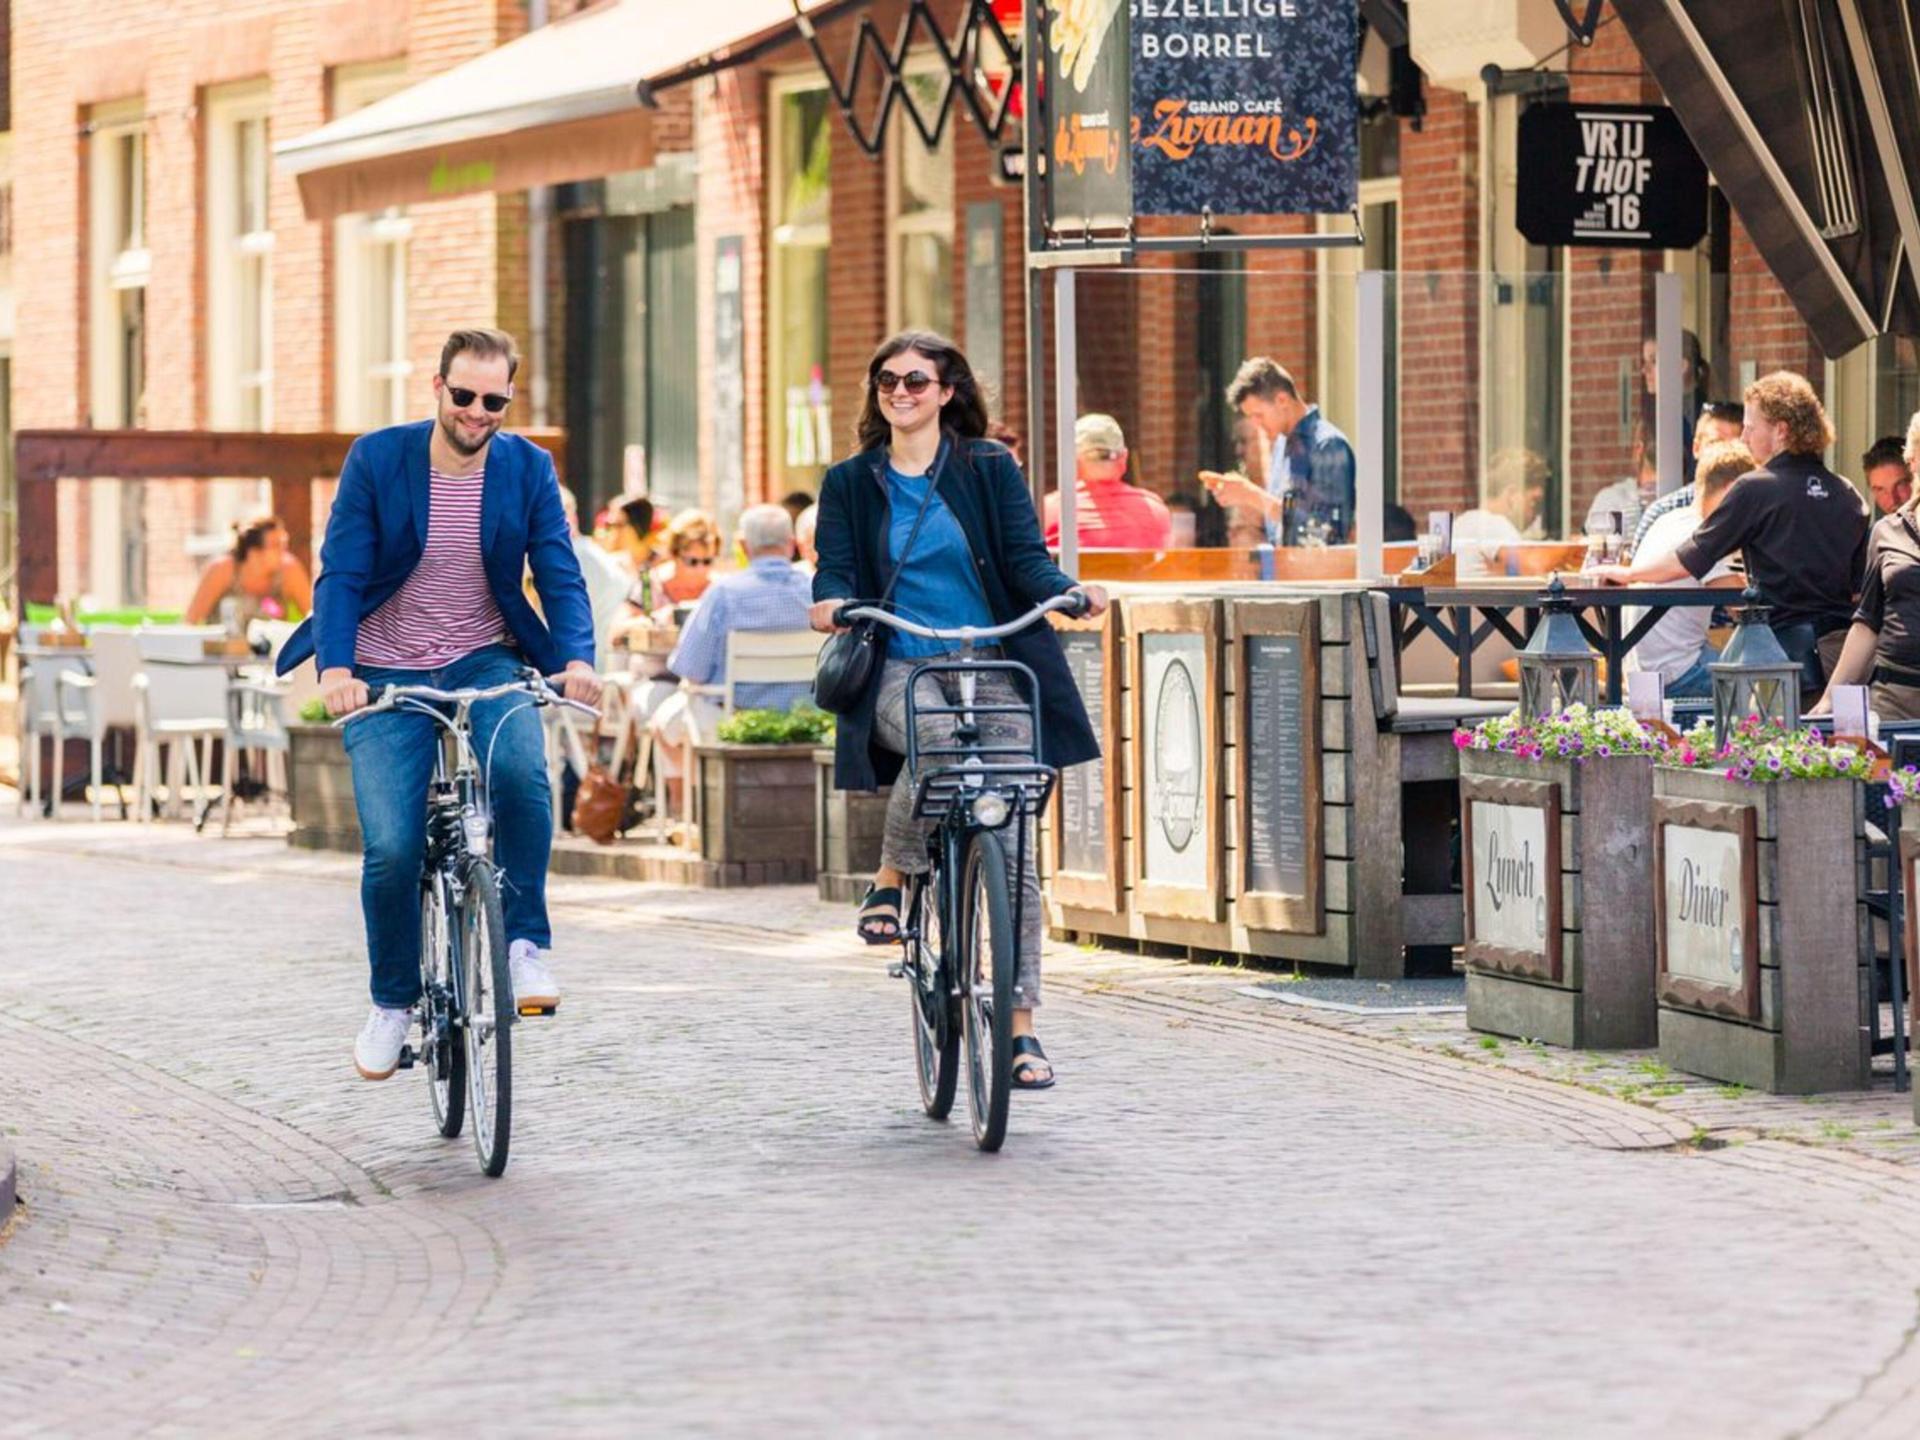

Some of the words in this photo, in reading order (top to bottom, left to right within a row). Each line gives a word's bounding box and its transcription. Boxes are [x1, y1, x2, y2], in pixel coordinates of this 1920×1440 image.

[1129, 0, 1297, 17] EZELLIGE
[1142, 33, 1273, 58] BORREL
[1188, 100, 1239, 114] GRAND
[1243, 97, 1284, 114] CAFÉ
[1141, 98, 1318, 161] Zwaan
[1581, 121, 1644, 158] VRIJ
[1575, 157, 1652, 193] THOF
[1605, 193, 1641, 230] 16
[1679, 856, 1729, 928] Diner
